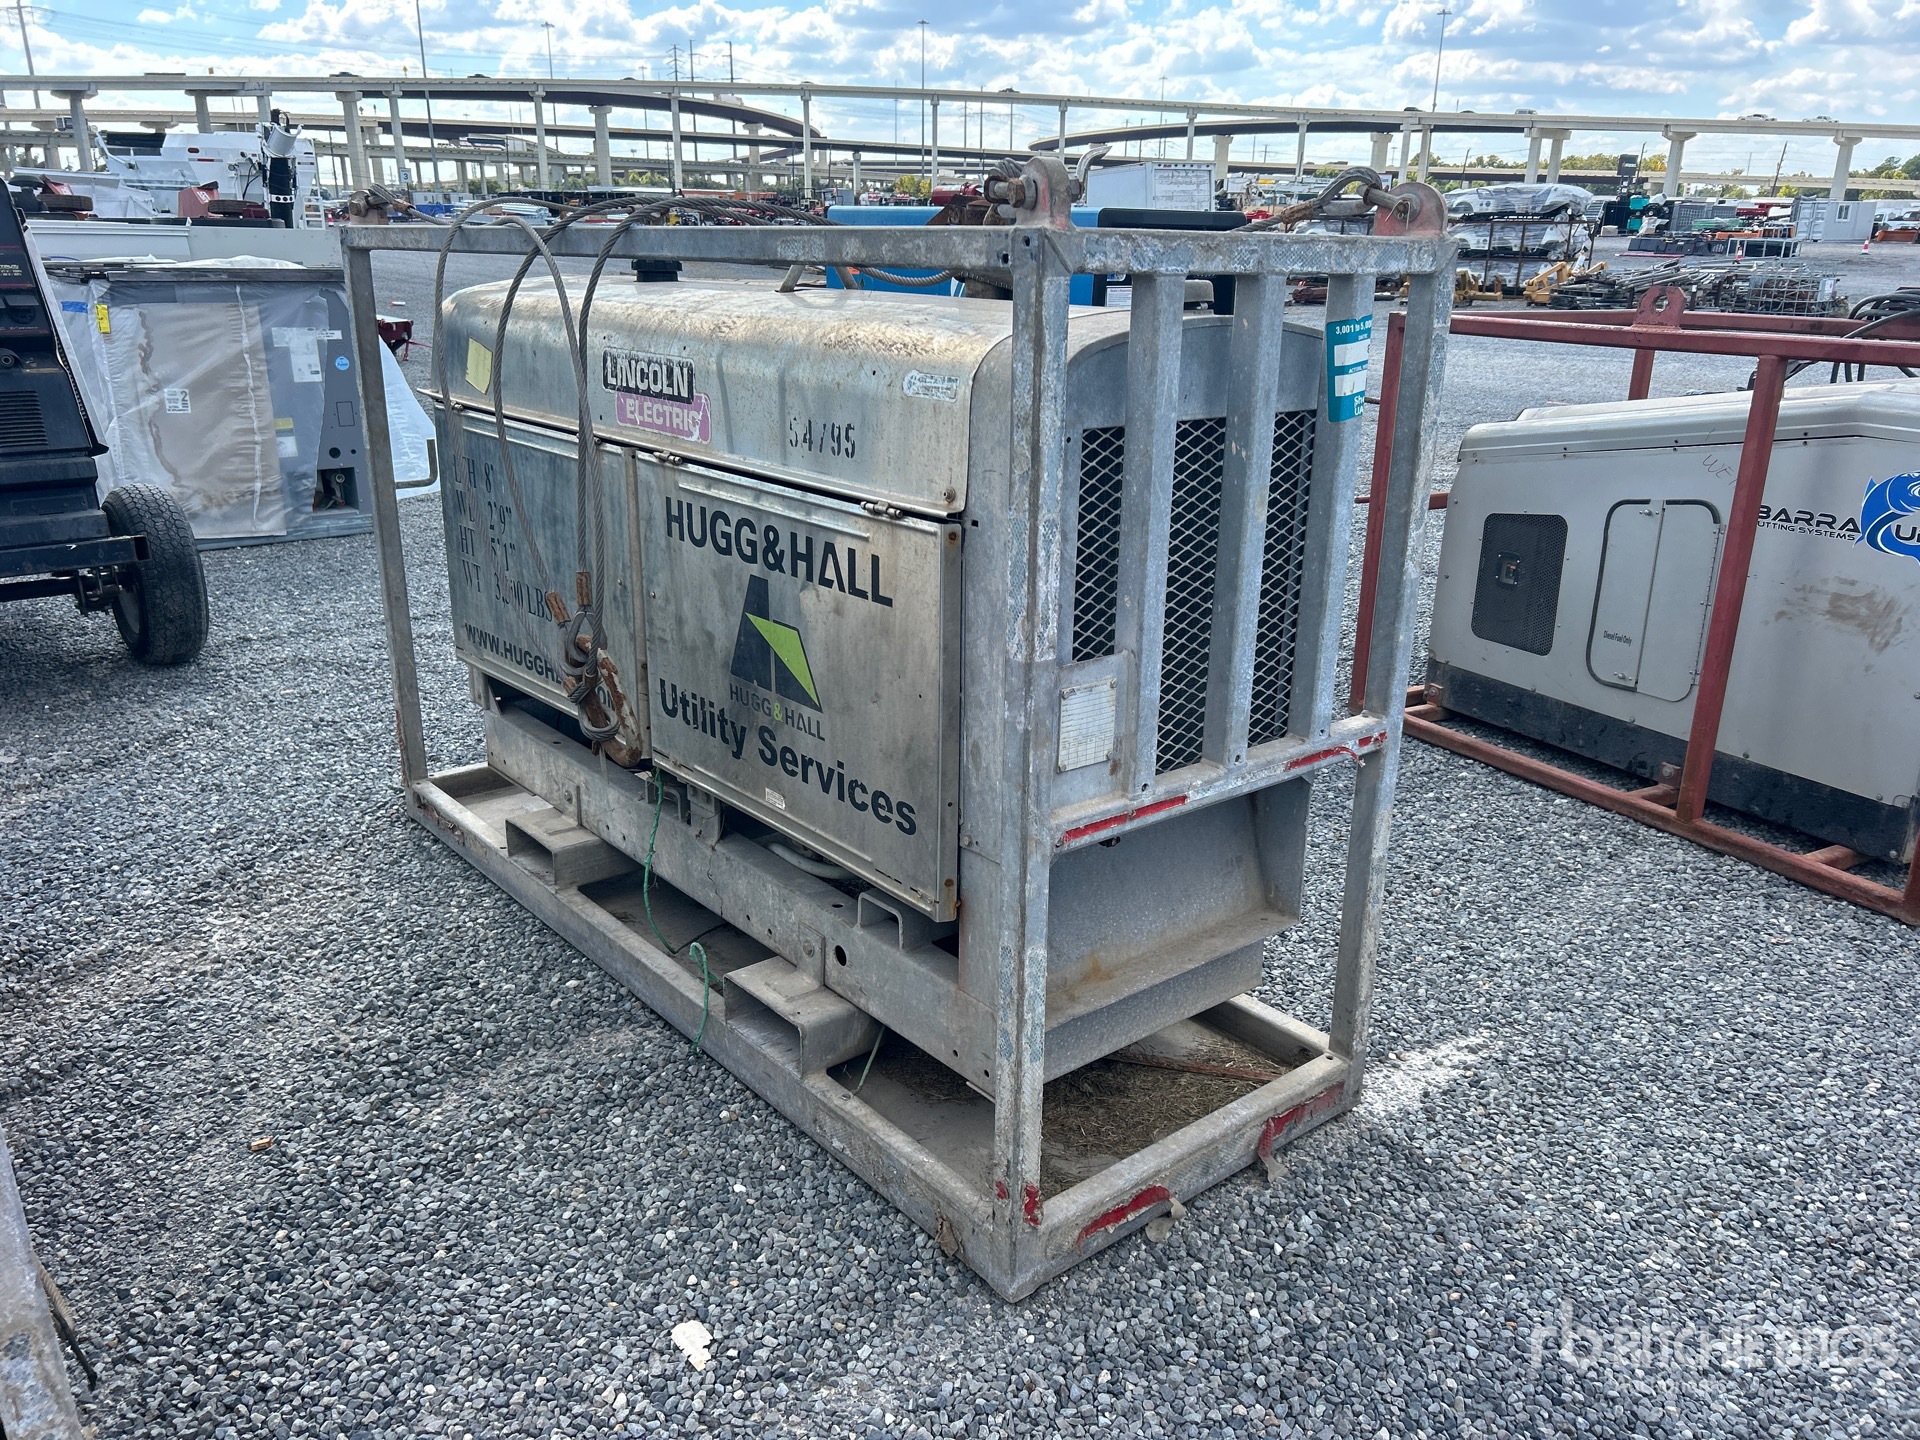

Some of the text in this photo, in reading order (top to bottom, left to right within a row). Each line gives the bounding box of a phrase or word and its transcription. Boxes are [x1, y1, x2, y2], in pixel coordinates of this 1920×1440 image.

[606, 355, 689, 398] LINCOLN
[625, 398, 701, 433] ELECTRIC
[1757, 519, 1856, 541] UTTING SYSTEMS
[1758, 504, 1861, 534] BARRA
[459, 525, 475, 557] HT
[665, 496, 894, 608] HUGG&HALL
[462, 559, 481, 593] WT
[526, 584, 553, 622] LBS
[729, 683, 826, 742] HUGG&HALL
[659, 678, 917, 836] Utility Services
